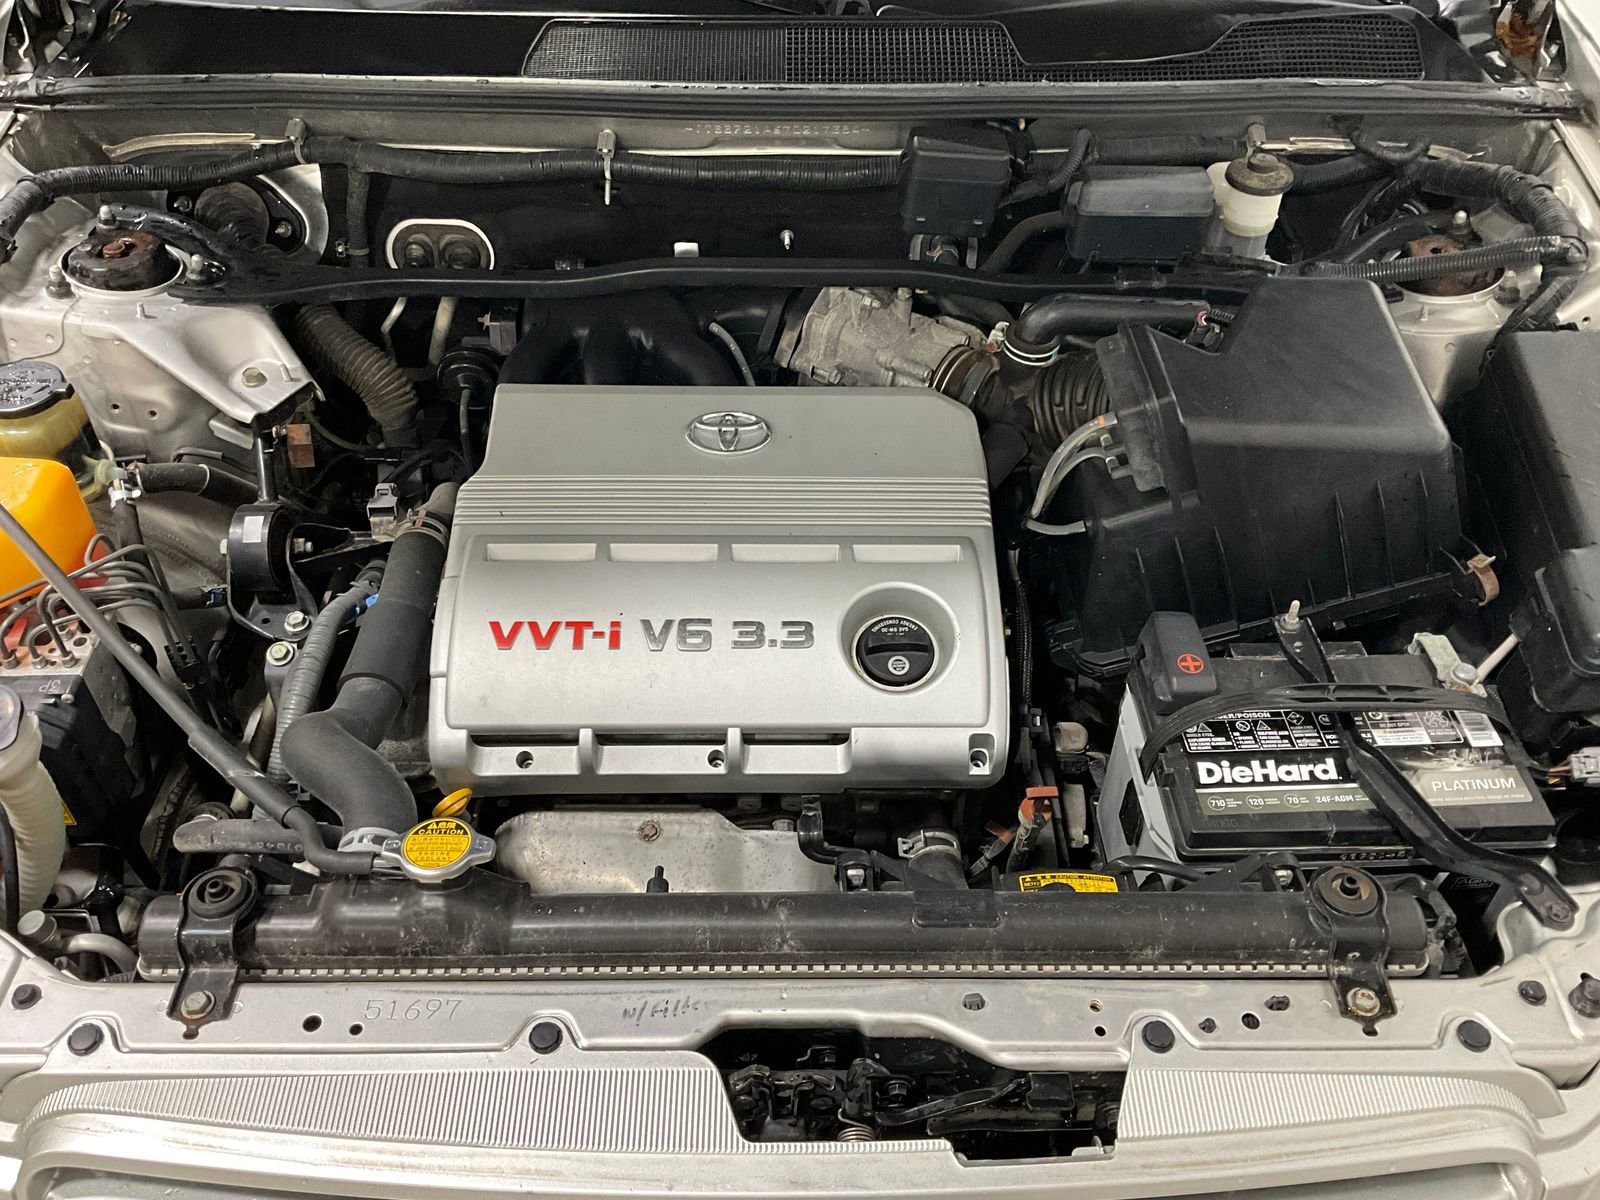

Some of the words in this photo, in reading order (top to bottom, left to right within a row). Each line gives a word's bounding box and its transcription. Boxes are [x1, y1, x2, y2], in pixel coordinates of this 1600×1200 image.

[489, 620, 622, 651] VVT-i
[639, 618, 713, 652] V6
[730, 619, 815, 650] 3.3
[1431, 777, 1517, 793] PLATINUM
[1209, 799, 1226, 808] 710
[1248, 797, 1265, 807] 120
[1286, 796, 1300, 805] 70
[363, 998, 463, 1021] 51697
